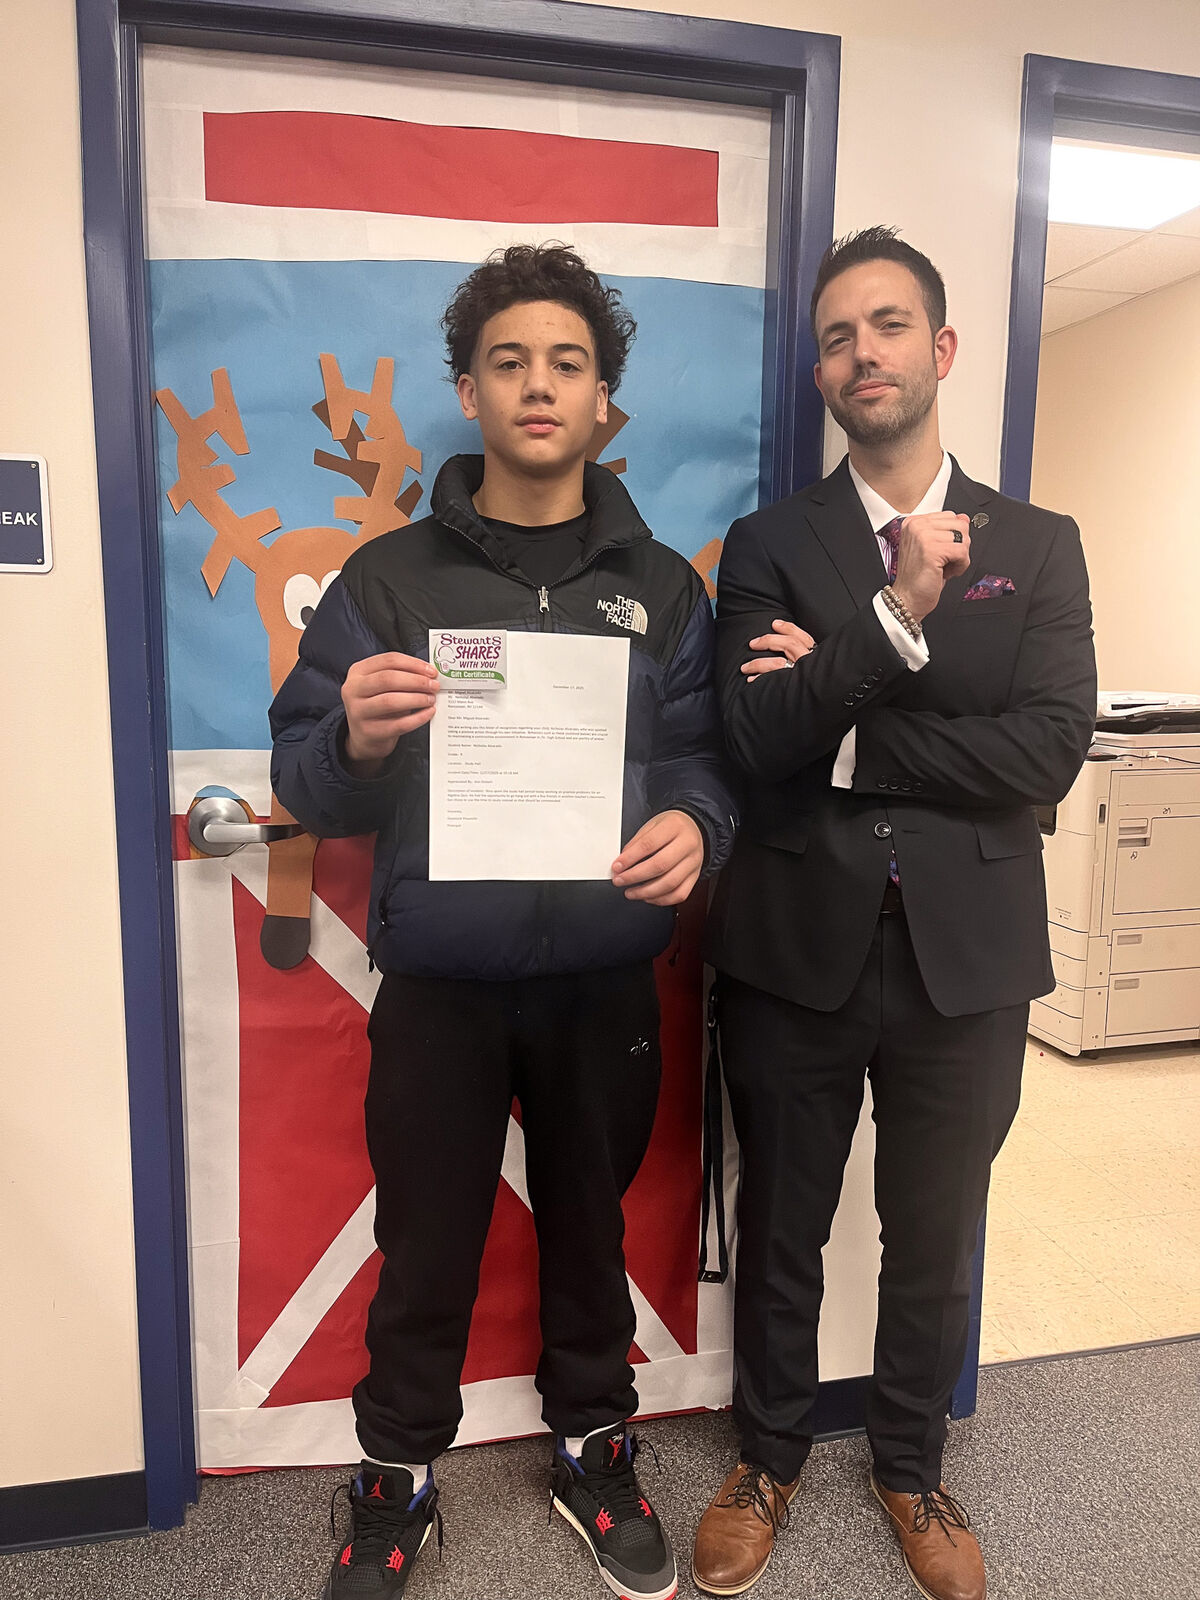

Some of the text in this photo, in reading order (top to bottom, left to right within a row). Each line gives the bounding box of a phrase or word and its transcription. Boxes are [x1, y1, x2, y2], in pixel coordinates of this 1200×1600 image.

[0, 511, 38, 526] EAK
[597, 599, 633, 619] NORTH
[615, 594, 635, 610] THE
[606, 612, 632, 629] FACE
[455, 645, 502, 660] SHARES
